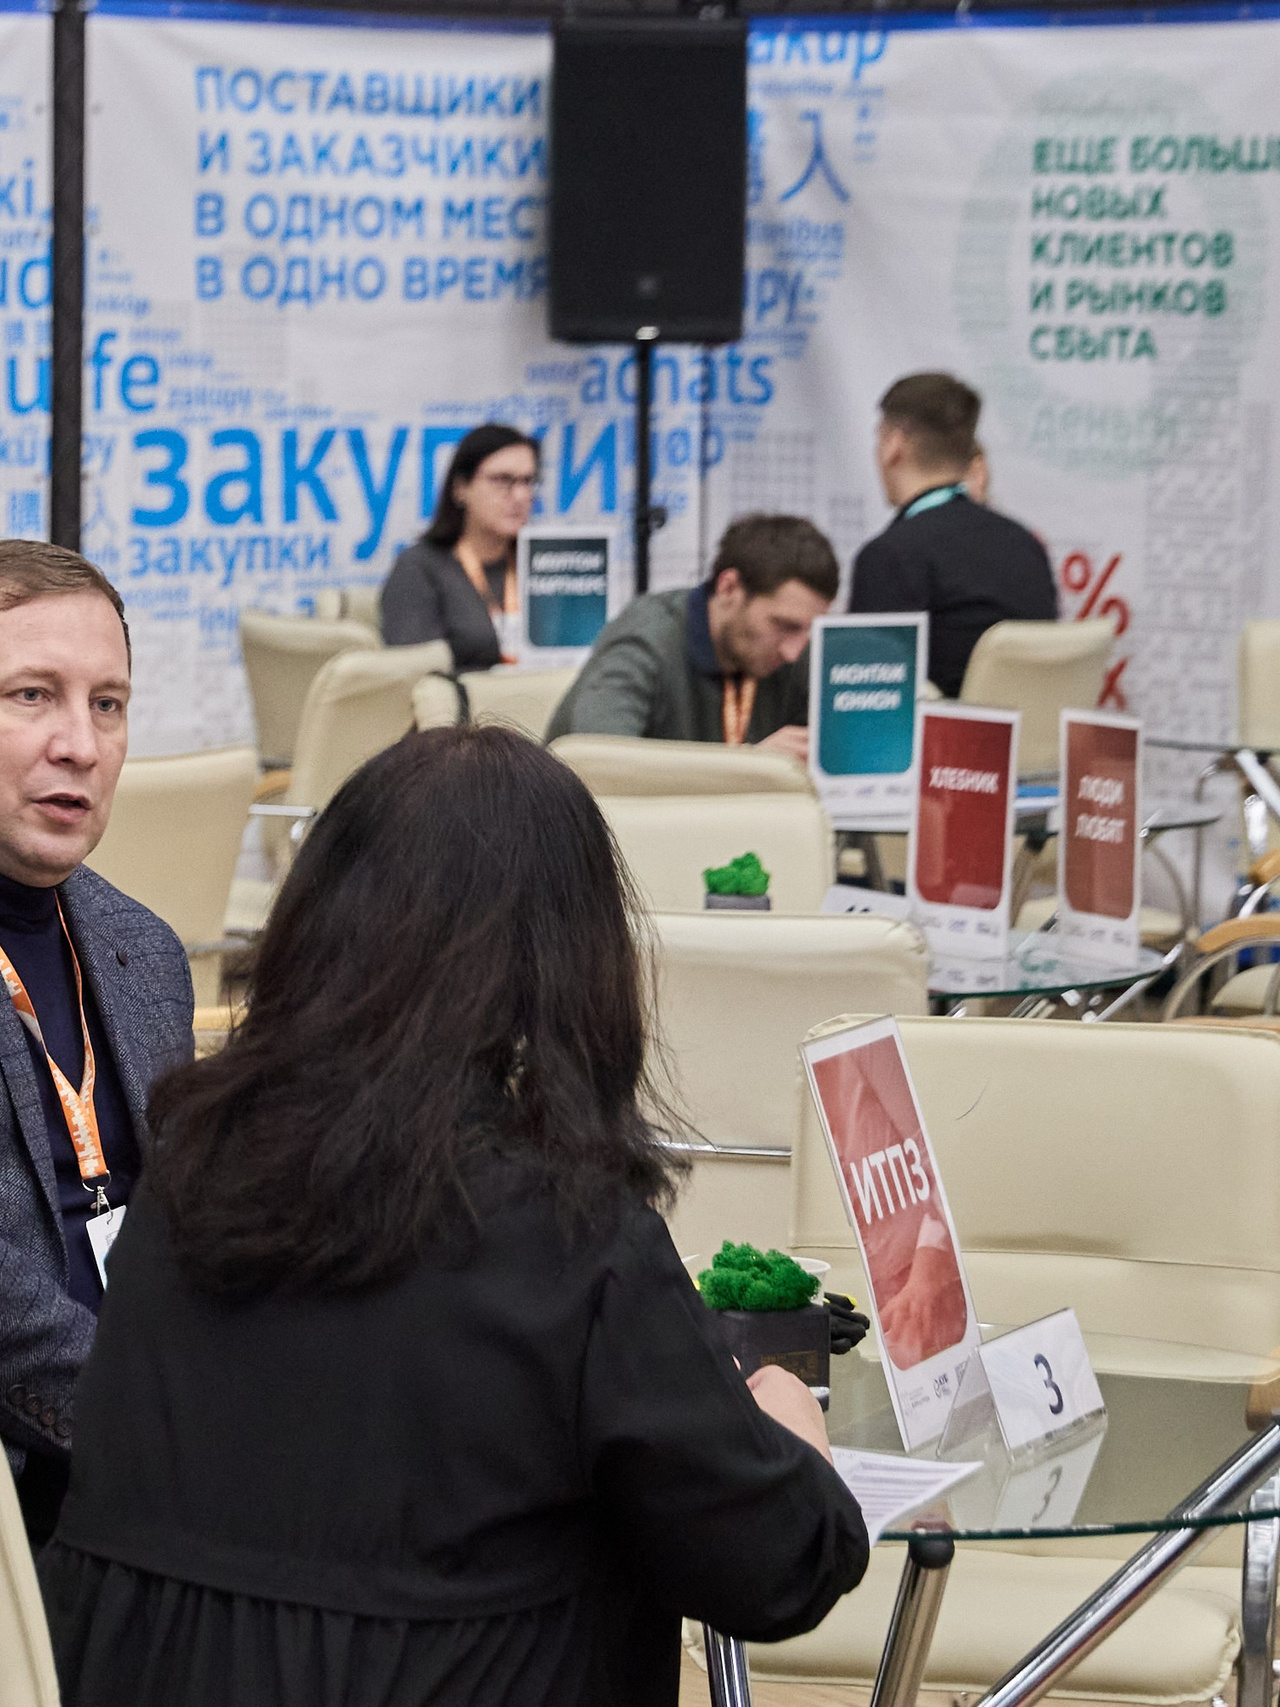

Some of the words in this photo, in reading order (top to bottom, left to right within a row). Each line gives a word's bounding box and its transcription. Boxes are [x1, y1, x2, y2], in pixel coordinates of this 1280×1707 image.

[193, 66, 542, 119] ПОСТАВЩИКИ
[197, 130, 231, 176] И
[247, 133, 549, 180] ЗАКАЗЧИКИ
[1031, 136, 1117, 175] ЕЩЕ
[194, 194, 225, 239] В
[243, 194, 421, 245] ОДНОМ
[442, 197, 543, 242] МЕС
[1031, 184, 1169, 220] НОВЫХ
[1031, 230, 1234, 268] КЛИЕНТОВ
[194, 256, 225, 301] В
[241, 255, 387, 308] ОДНО
[1030, 280, 1054, 313] И
[1065, 279, 1227, 317] РЫНКОВ
[1029, 324, 1158, 361] СБЫТА
[132, 424, 616, 562] закупи
[131, 535, 332, 588] закупки
[1034, 1353, 1064, 1415] 3
